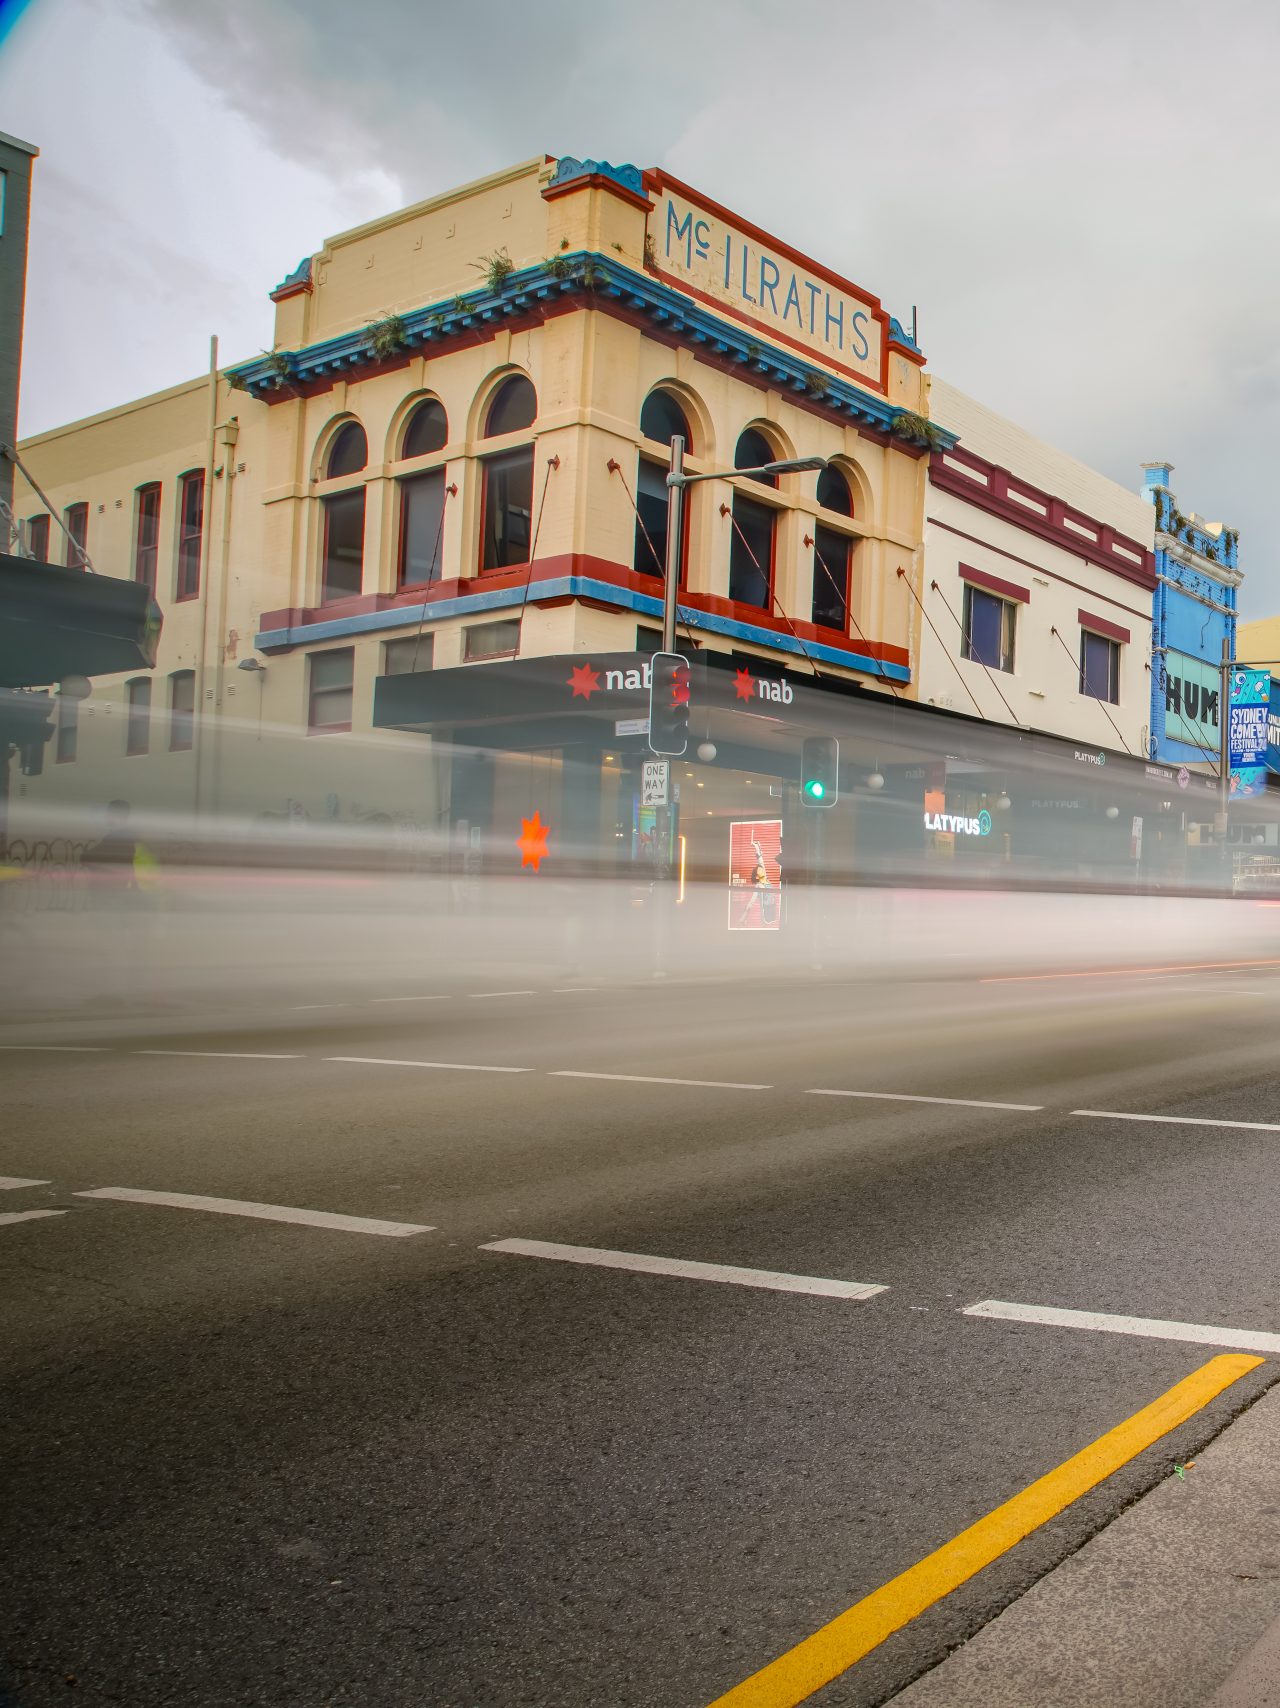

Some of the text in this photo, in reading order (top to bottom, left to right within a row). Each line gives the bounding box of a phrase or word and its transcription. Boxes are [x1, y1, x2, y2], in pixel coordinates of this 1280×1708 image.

[758, 679, 794, 705] nab
[1166, 673, 1219, 727] HUM
[1231, 707, 1268, 724] SYDNEY
[1231, 723, 1267, 739] COMEDY
[1231, 738, 1258, 750] FESTIVAL
[1074, 751, 1101, 766] PLATYPUS
[646, 765, 664, 776] ONE
[645, 779, 665, 790] WAY
